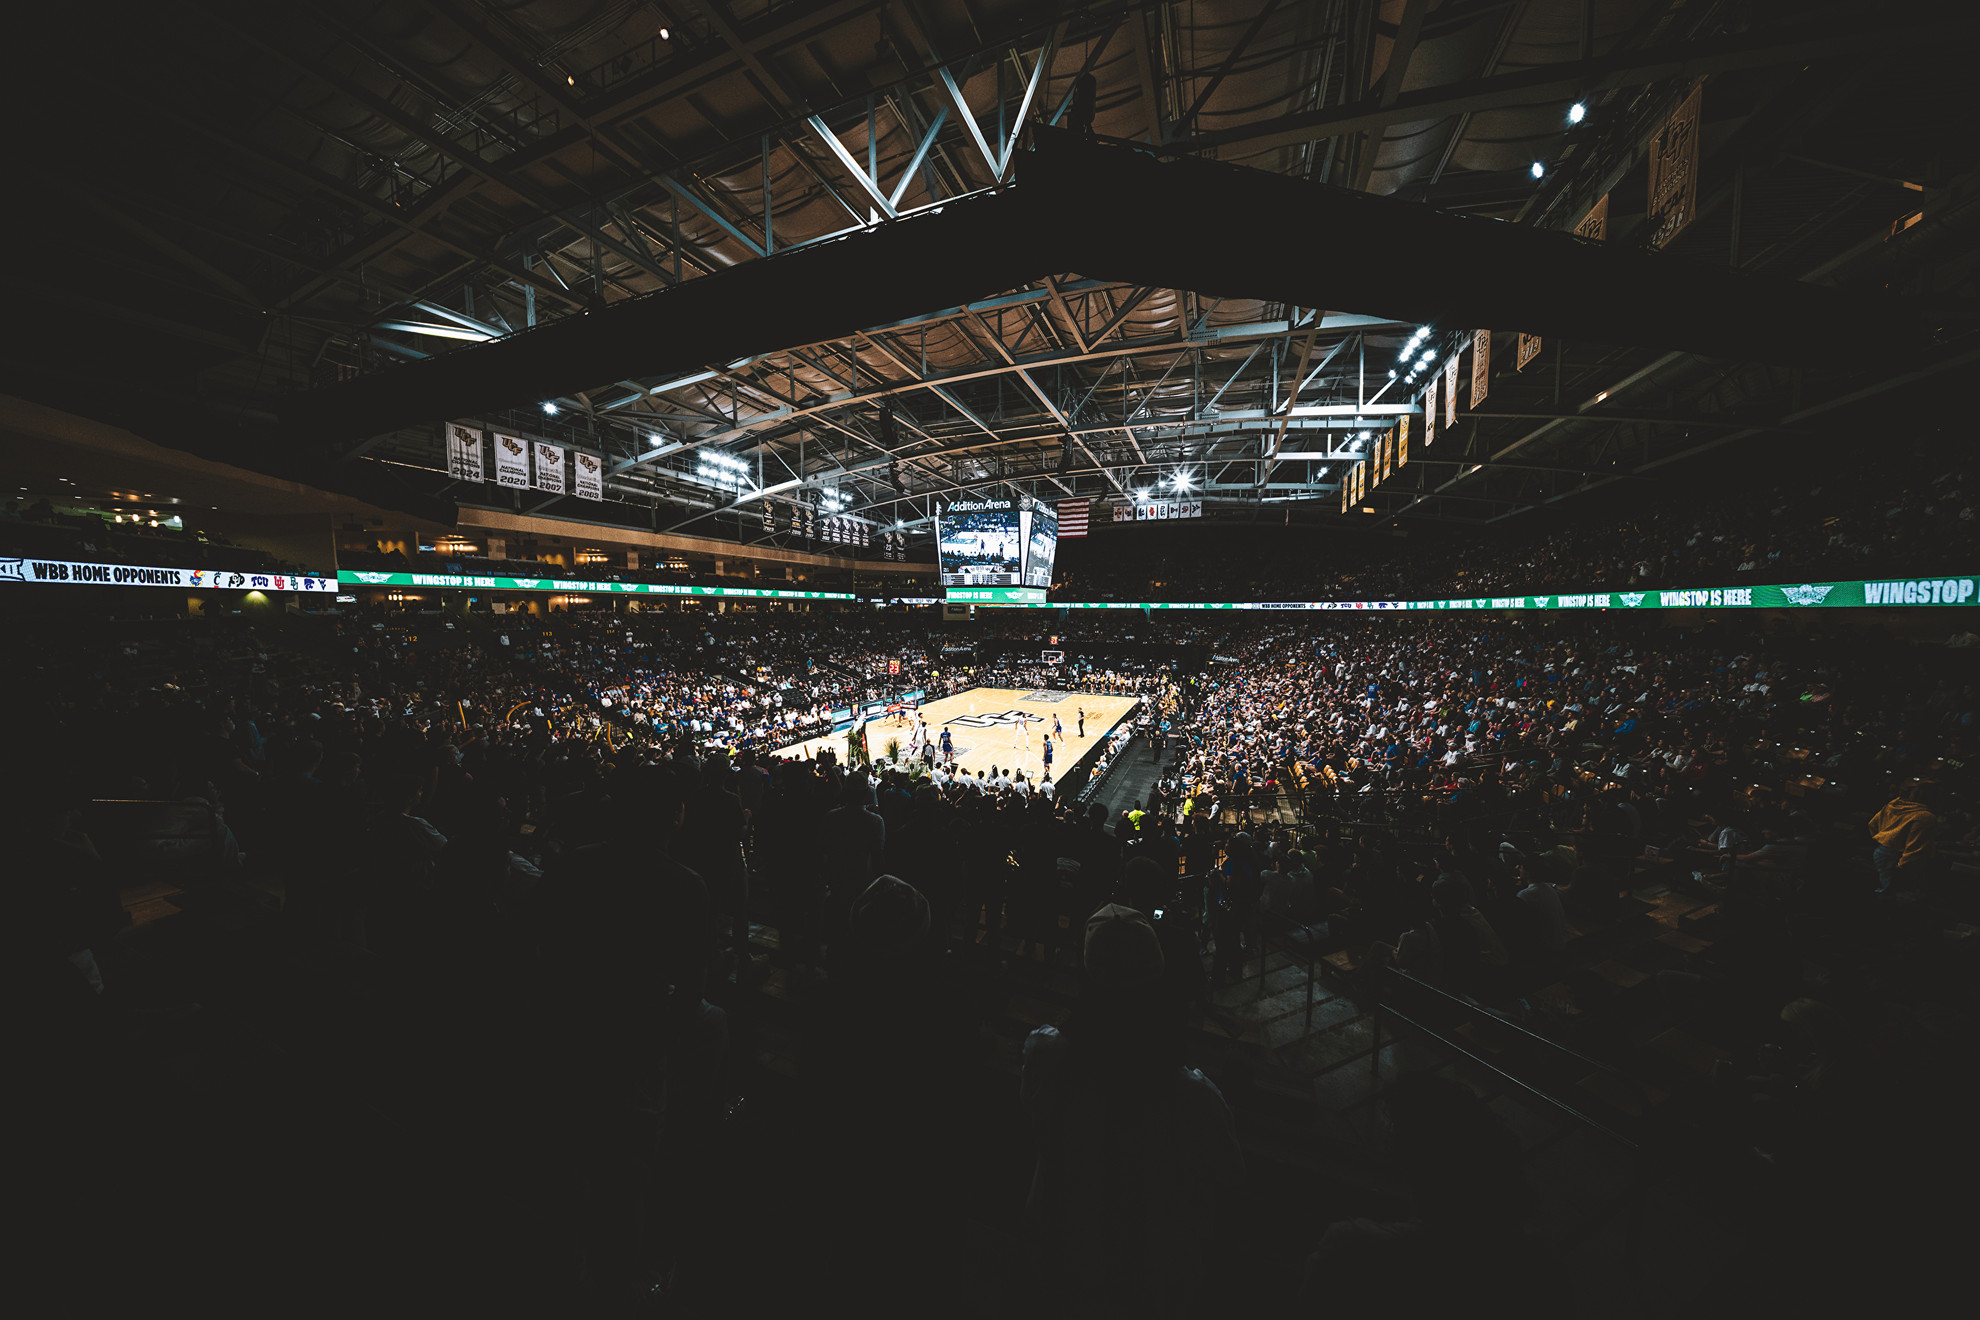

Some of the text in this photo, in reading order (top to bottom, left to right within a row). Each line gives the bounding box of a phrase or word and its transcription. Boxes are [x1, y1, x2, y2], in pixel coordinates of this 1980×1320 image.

[454, 427, 477, 446] UCF
[502, 437, 523, 456] UCF
[539, 445, 560, 464] UCF
[579, 454, 598, 473] UCF
[452, 467, 480, 479] 2024
[500, 475, 527, 486] 2020
[539, 481, 562, 491] 2007
[578, 490, 600, 499] 2003
[32, 562, 181, 584] WBB HOME OPPONENTS
[251, 576, 269, 588] TCU
[412, 574, 496, 587] WINGSTOP IS HERE
[553, 581, 588, 590] WINGSTOP
[596, 583, 612, 591] HERE
[1660, 588, 1752, 606] WINGSTOP IS HERE
[1864, 579, 1974, 604] WINGSTOP
[1558, 594, 1610, 607] WINGSTOP IS HERE
[889, 664, 899, 673] 23
